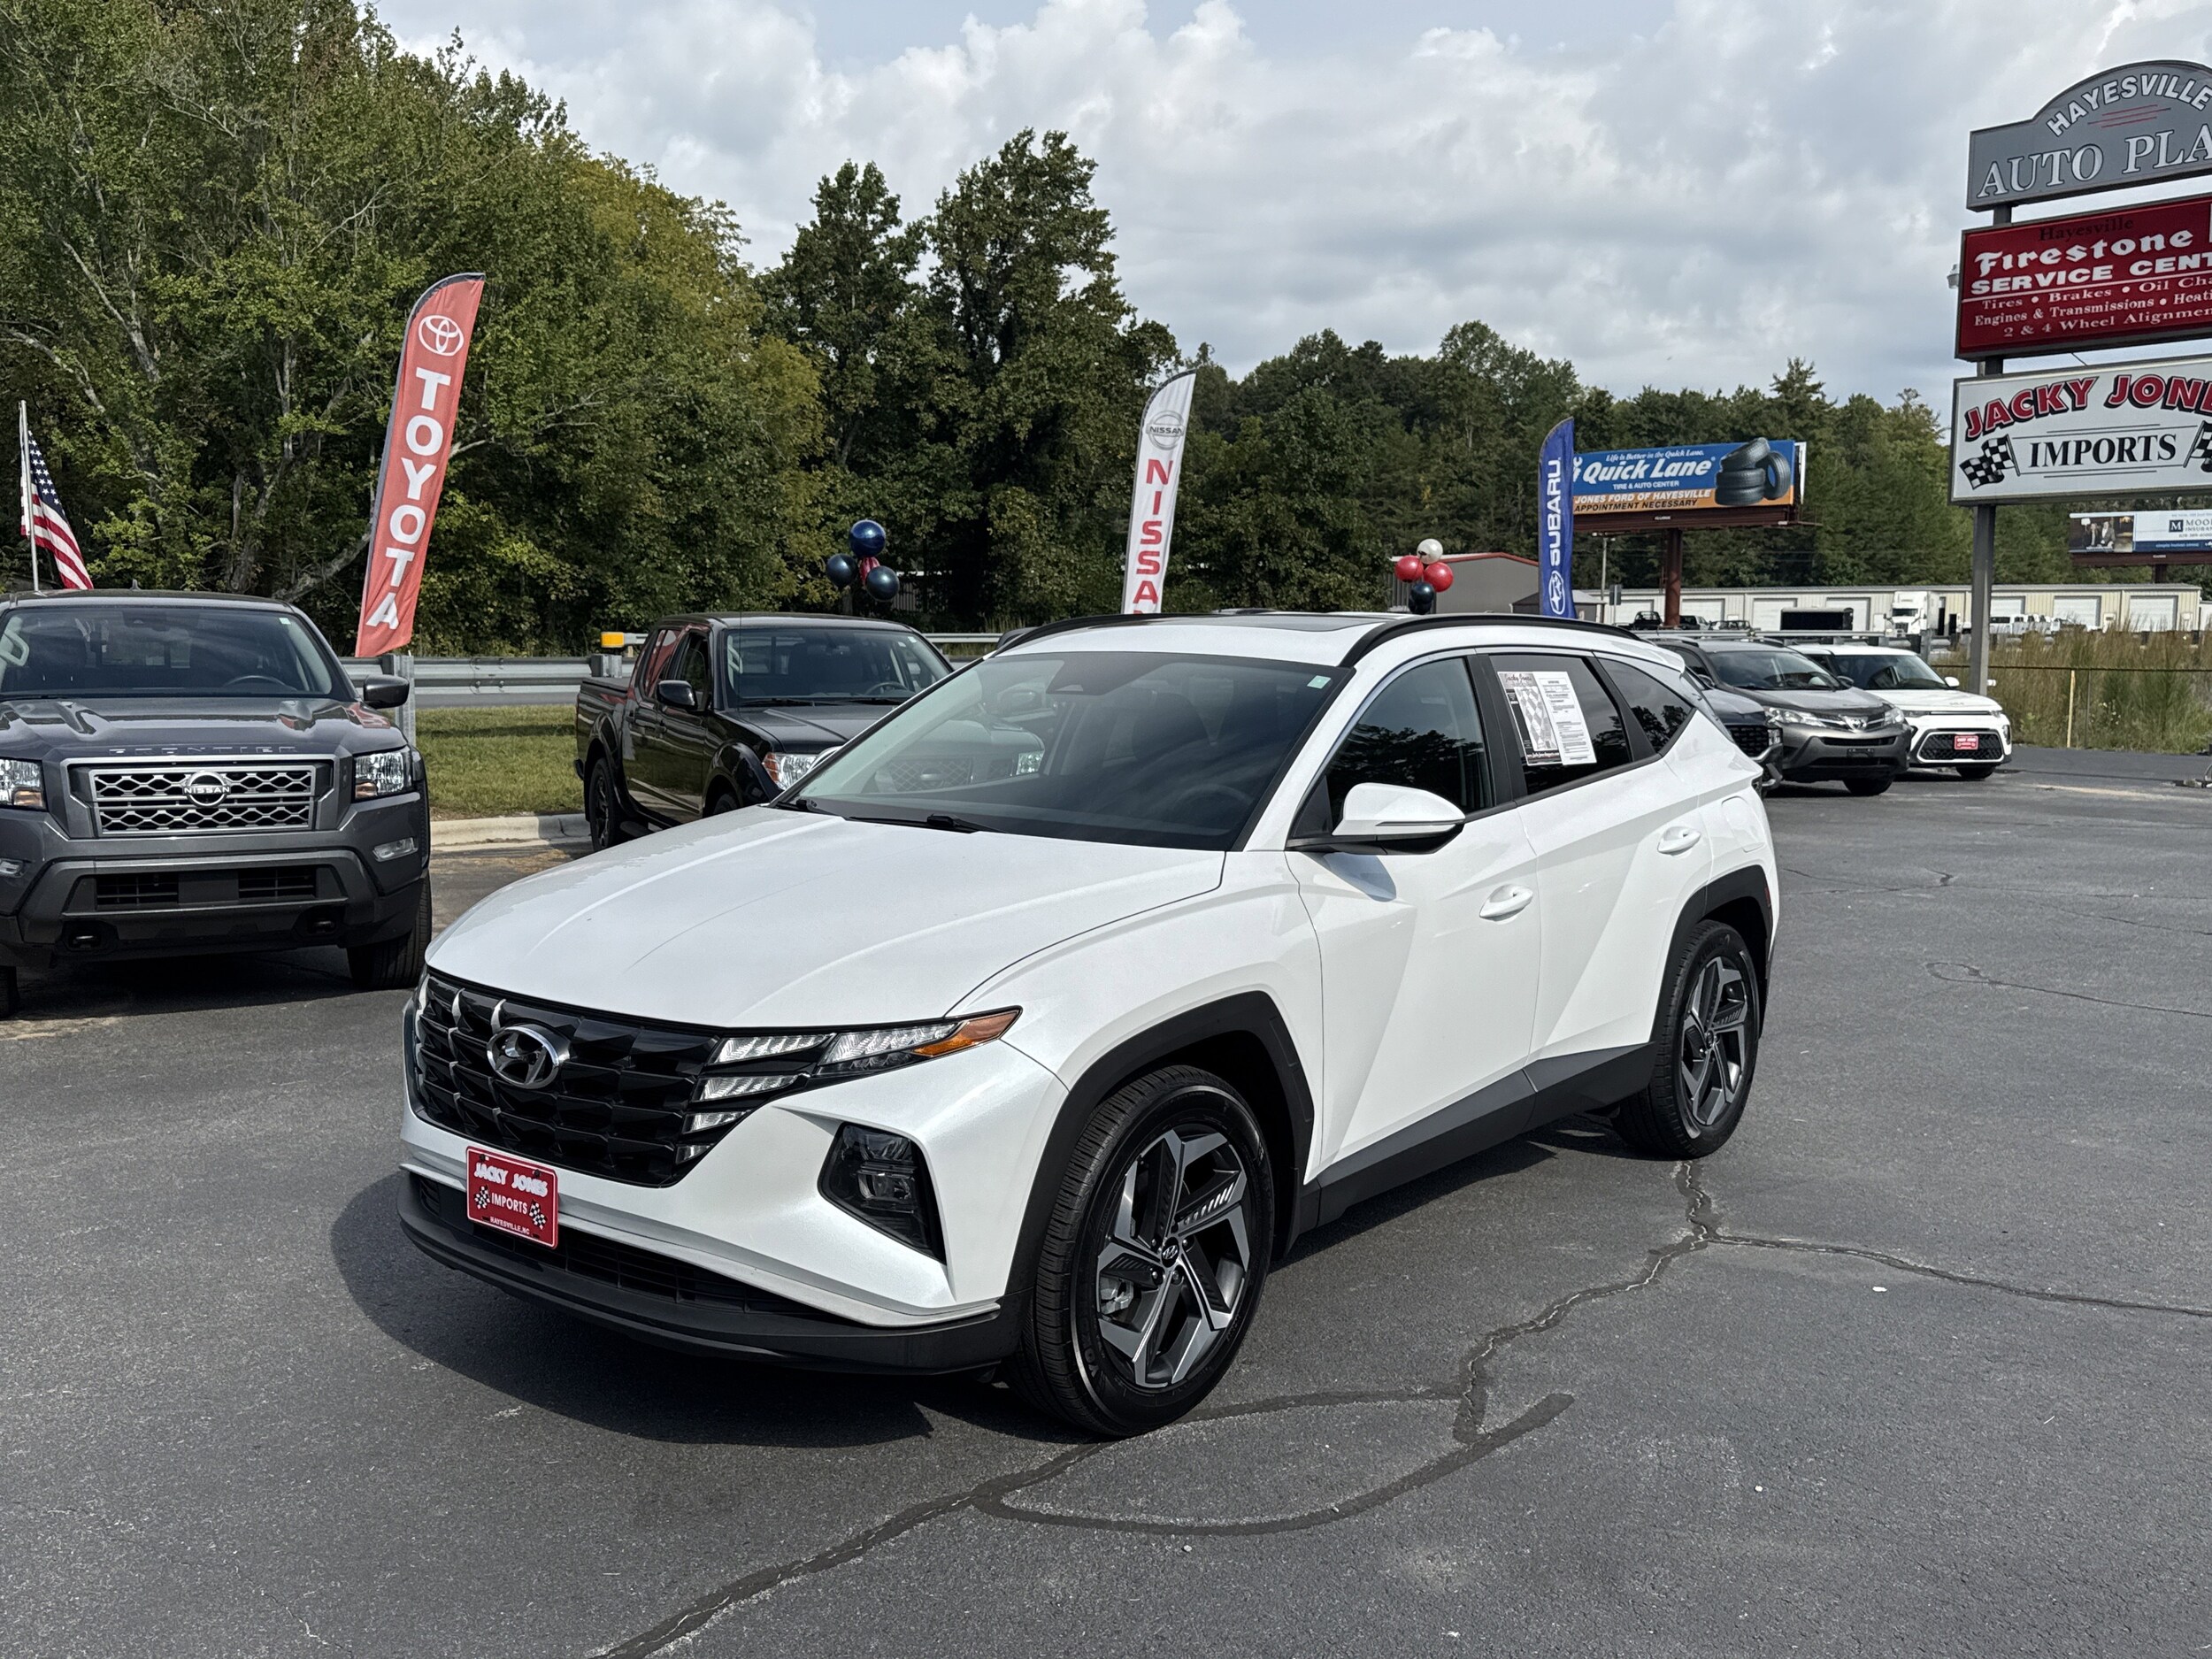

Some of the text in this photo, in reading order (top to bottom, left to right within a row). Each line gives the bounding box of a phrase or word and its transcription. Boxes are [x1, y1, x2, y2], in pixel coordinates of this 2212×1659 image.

[2046, 73, 2212, 136] HAYESVILLE
[1977, 123, 2212, 198] AUTO PLA
[2039, 217, 2133, 242] Hayesville
[1974, 229, 2193, 277] Firestone
[1970, 265, 2113, 295] SERVICE
[1982, 299, 2024, 310] Tires
[2048, 289, 2112, 303] Brakes
[2139, 280, 2170, 292] Oil
[1974, 312, 2028, 326] Engines
[2033, 308, 2044, 319] &
[2049, 298, 2154, 317] Transmissions
[2004, 327, 2014, 337] 2
[2020, 325, 2034, 335] &
[2041, 323, 2052, 333] 4
[2059, 316, 2115, 331] Wheel
[1965, 376, 2100, 442] JACKY
[1606, 454, 1619, 463] Life
[1664, 449, 1685, 458] Quick
[2028, 434, 2177, 468] IMPORTS
[1583, 457, 1712, 484] Quick Lane
[365, 367, 451, 629] TOYOTA
[1574, 499, 1698, 512] APPOINTMENT NECESSARY
[1575, 489, 1711, 504] JONES FORD OF HAYESVILLE
[1548, 460, 1561, 566] SUBARU
[1133, 459, 1173, 614] NISSA
[184, 786, 230, 795] NISSAN
[474, 1162, 548, 1197] JACKY JONES
[491, 1192, 528, 1215] IMPORTS
